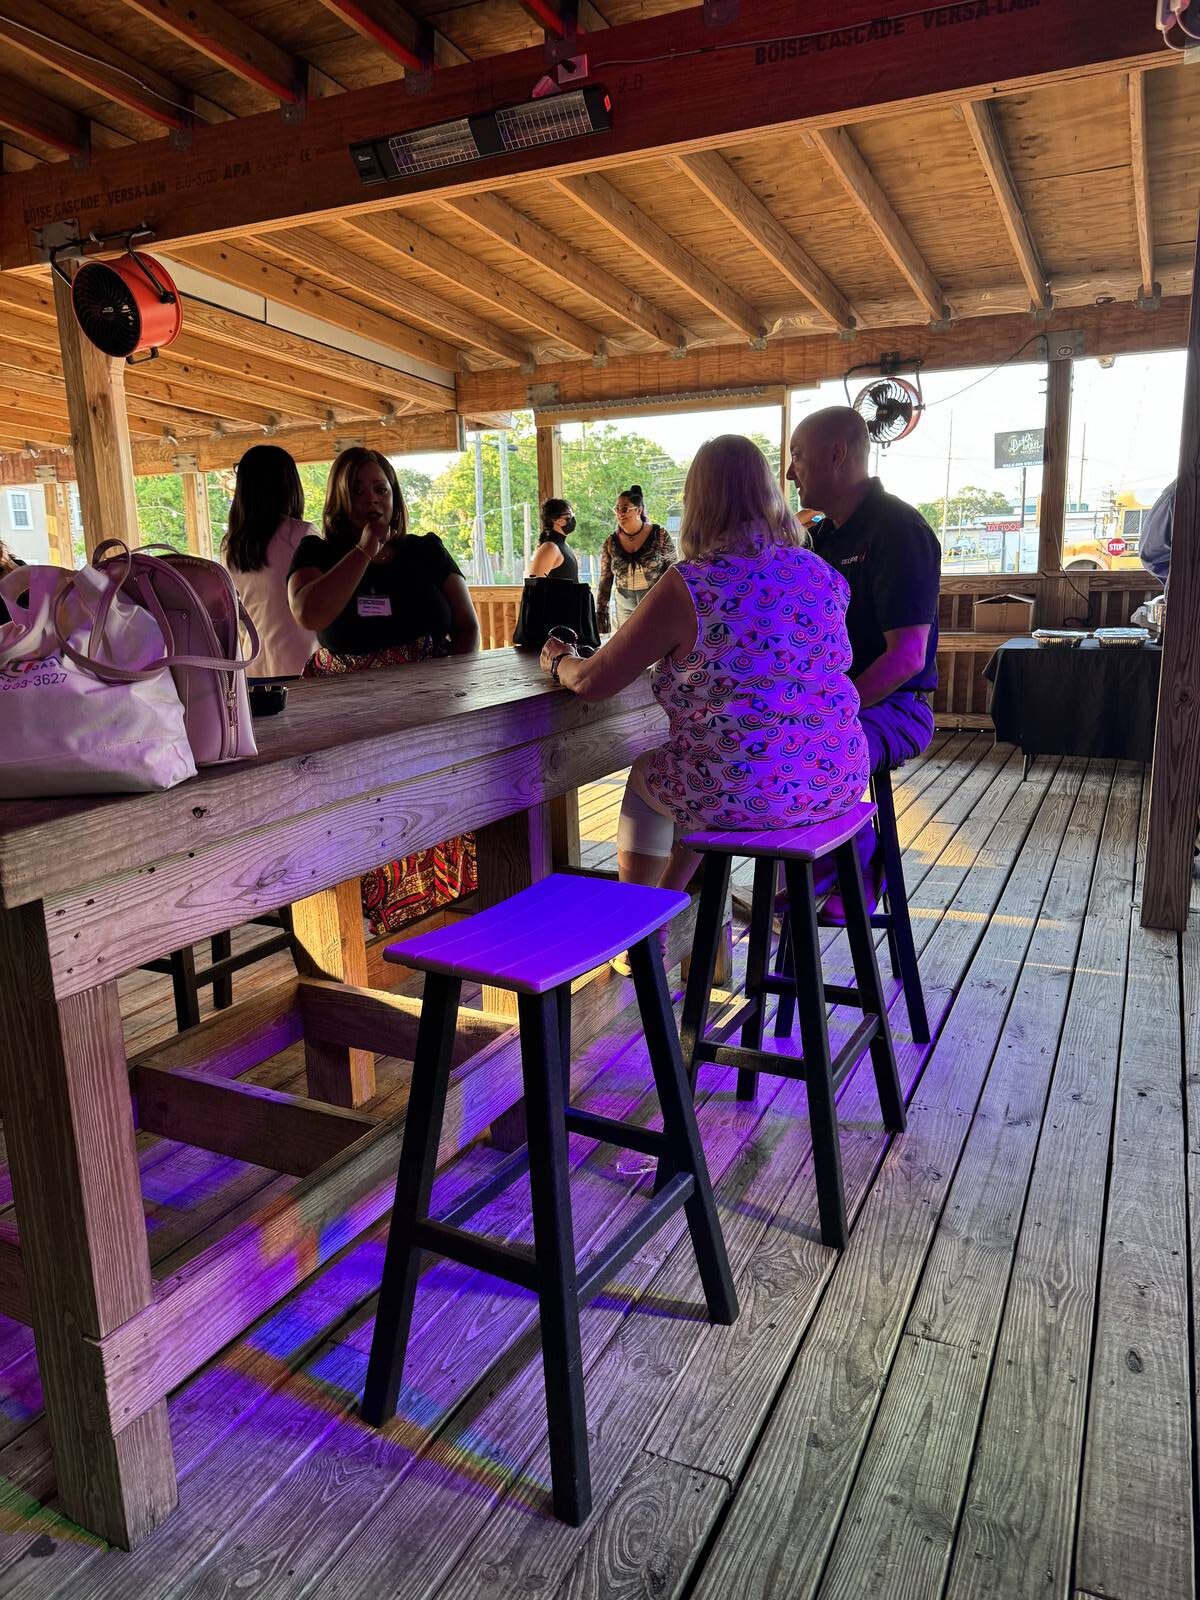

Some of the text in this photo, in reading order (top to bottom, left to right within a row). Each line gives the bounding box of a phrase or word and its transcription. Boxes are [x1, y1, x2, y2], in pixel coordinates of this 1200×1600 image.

[754, 37, 809, 65] BOISE
[814, 17, 905, 52] CASCADE
[54, 194, 100, 217] CASCADE
[107, 180, 166, 204] VERSA-LAM
[223, 161, 251, 180] APA
[987, 523, 1020, 531] TATTOOS
[1109, 543, 1125, 551] STOP
